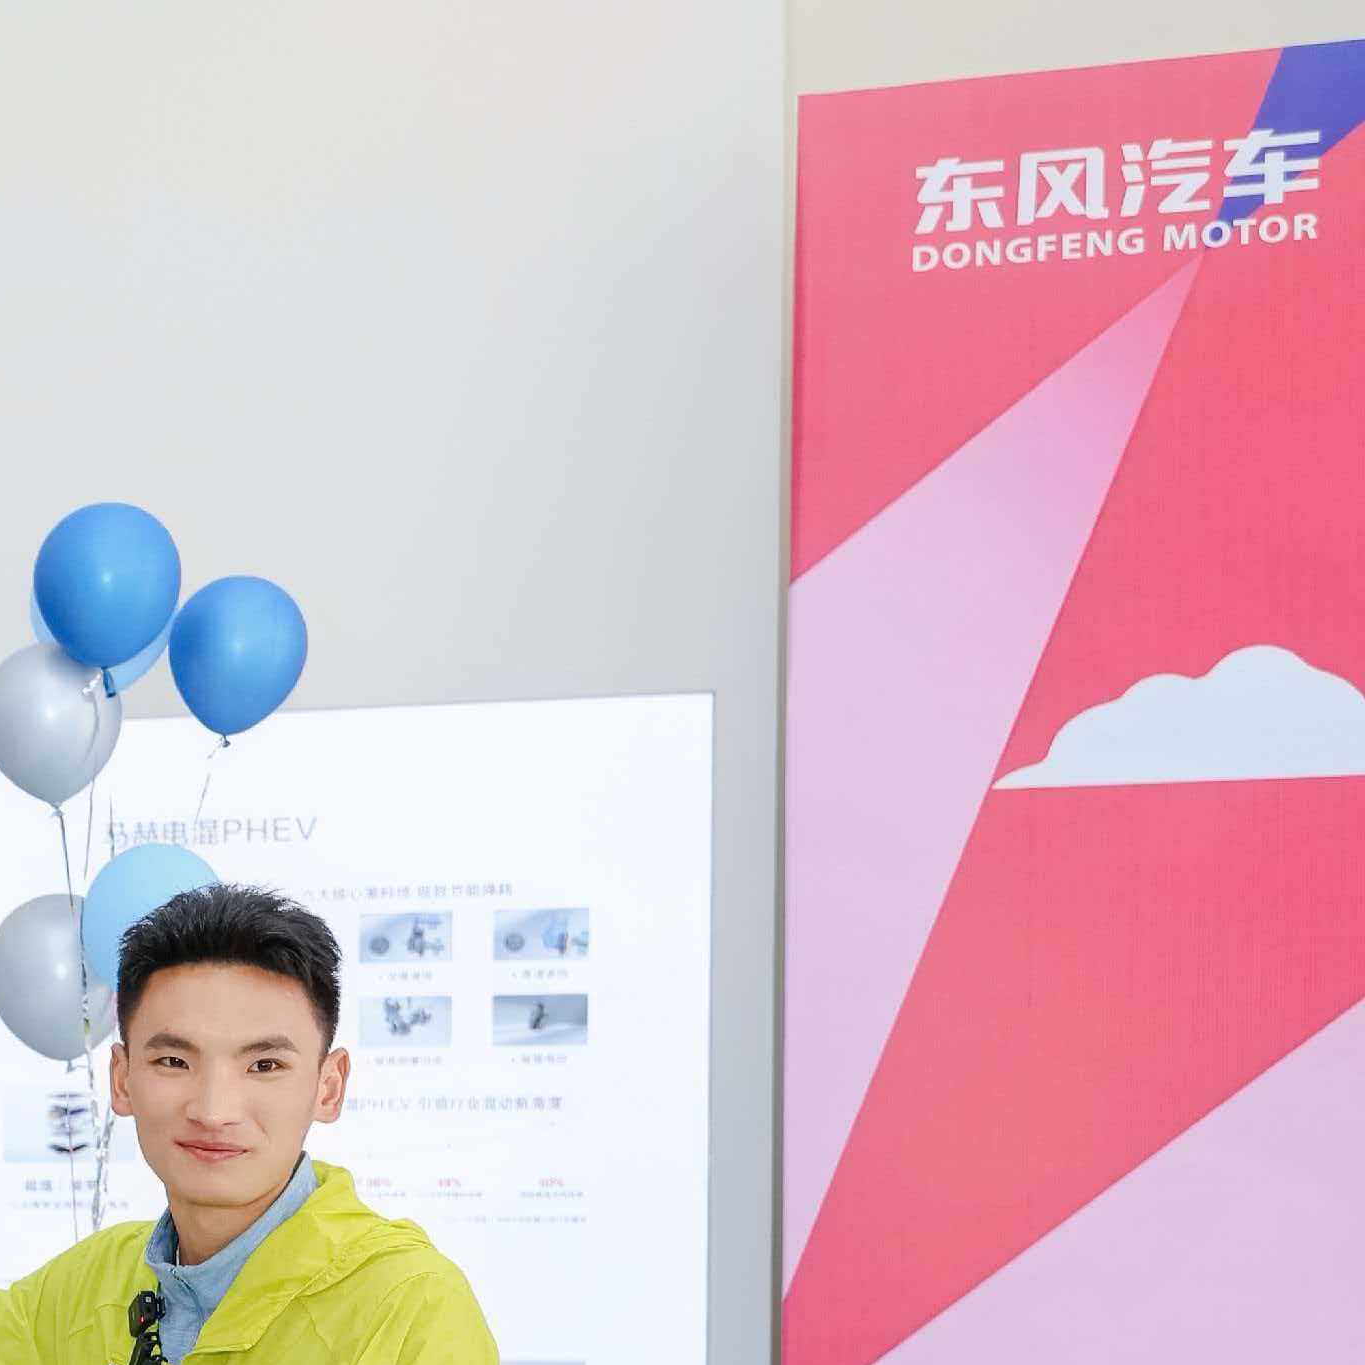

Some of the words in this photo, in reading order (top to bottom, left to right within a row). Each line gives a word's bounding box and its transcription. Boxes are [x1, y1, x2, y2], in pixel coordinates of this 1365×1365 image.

[914, 128, 1321, 235] 东风汽车
[912, 226, 1145, 273] DONGFENG
[1163, 213, 1319, 252] MOTOR
